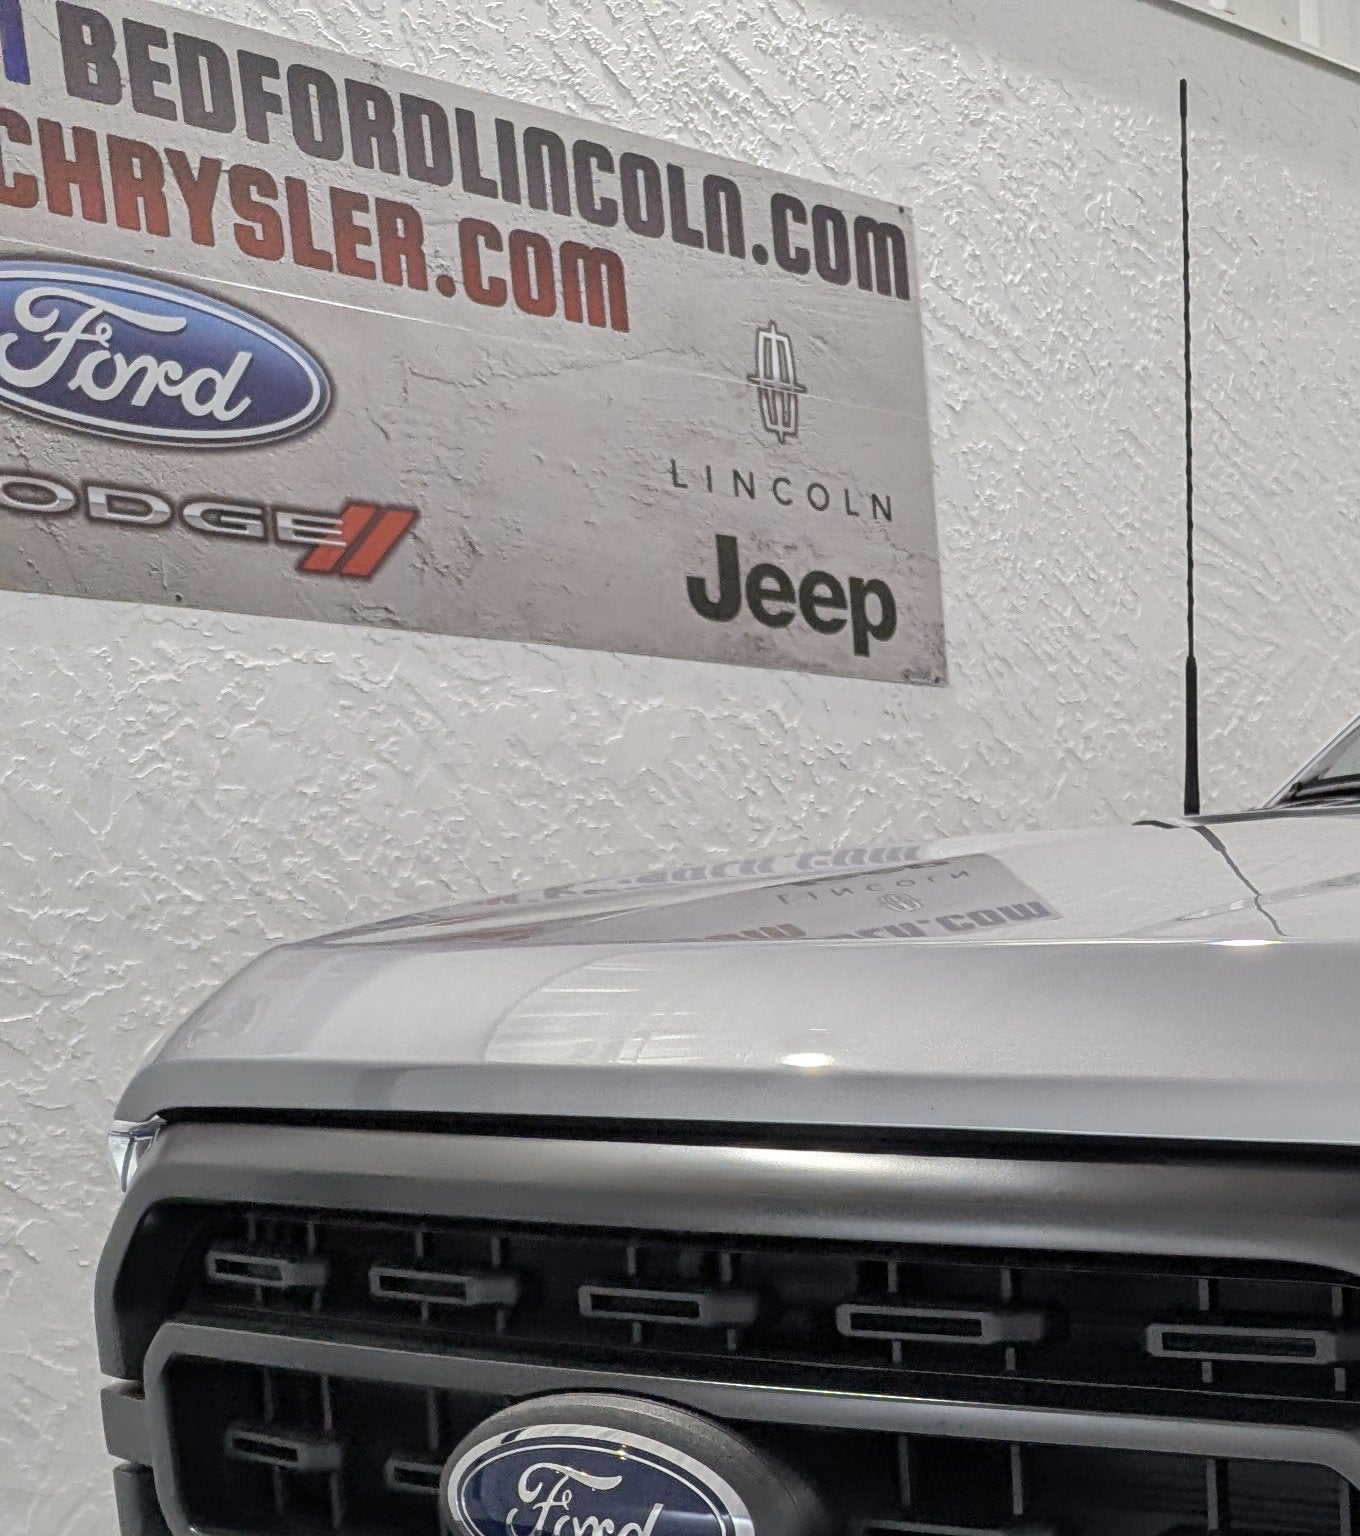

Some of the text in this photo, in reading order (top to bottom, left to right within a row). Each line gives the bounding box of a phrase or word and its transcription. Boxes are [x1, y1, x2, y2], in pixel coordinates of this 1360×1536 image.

[55, 0, 910, 301] BEDFORDLINCOLN.COM
[0, 107, 629, 333] CHRYSLER.COM
[0, 286, 253, 422] Ford
[670, 459, 893, 523] LINCOLN
[686, 533, 898, 658] Jeep
